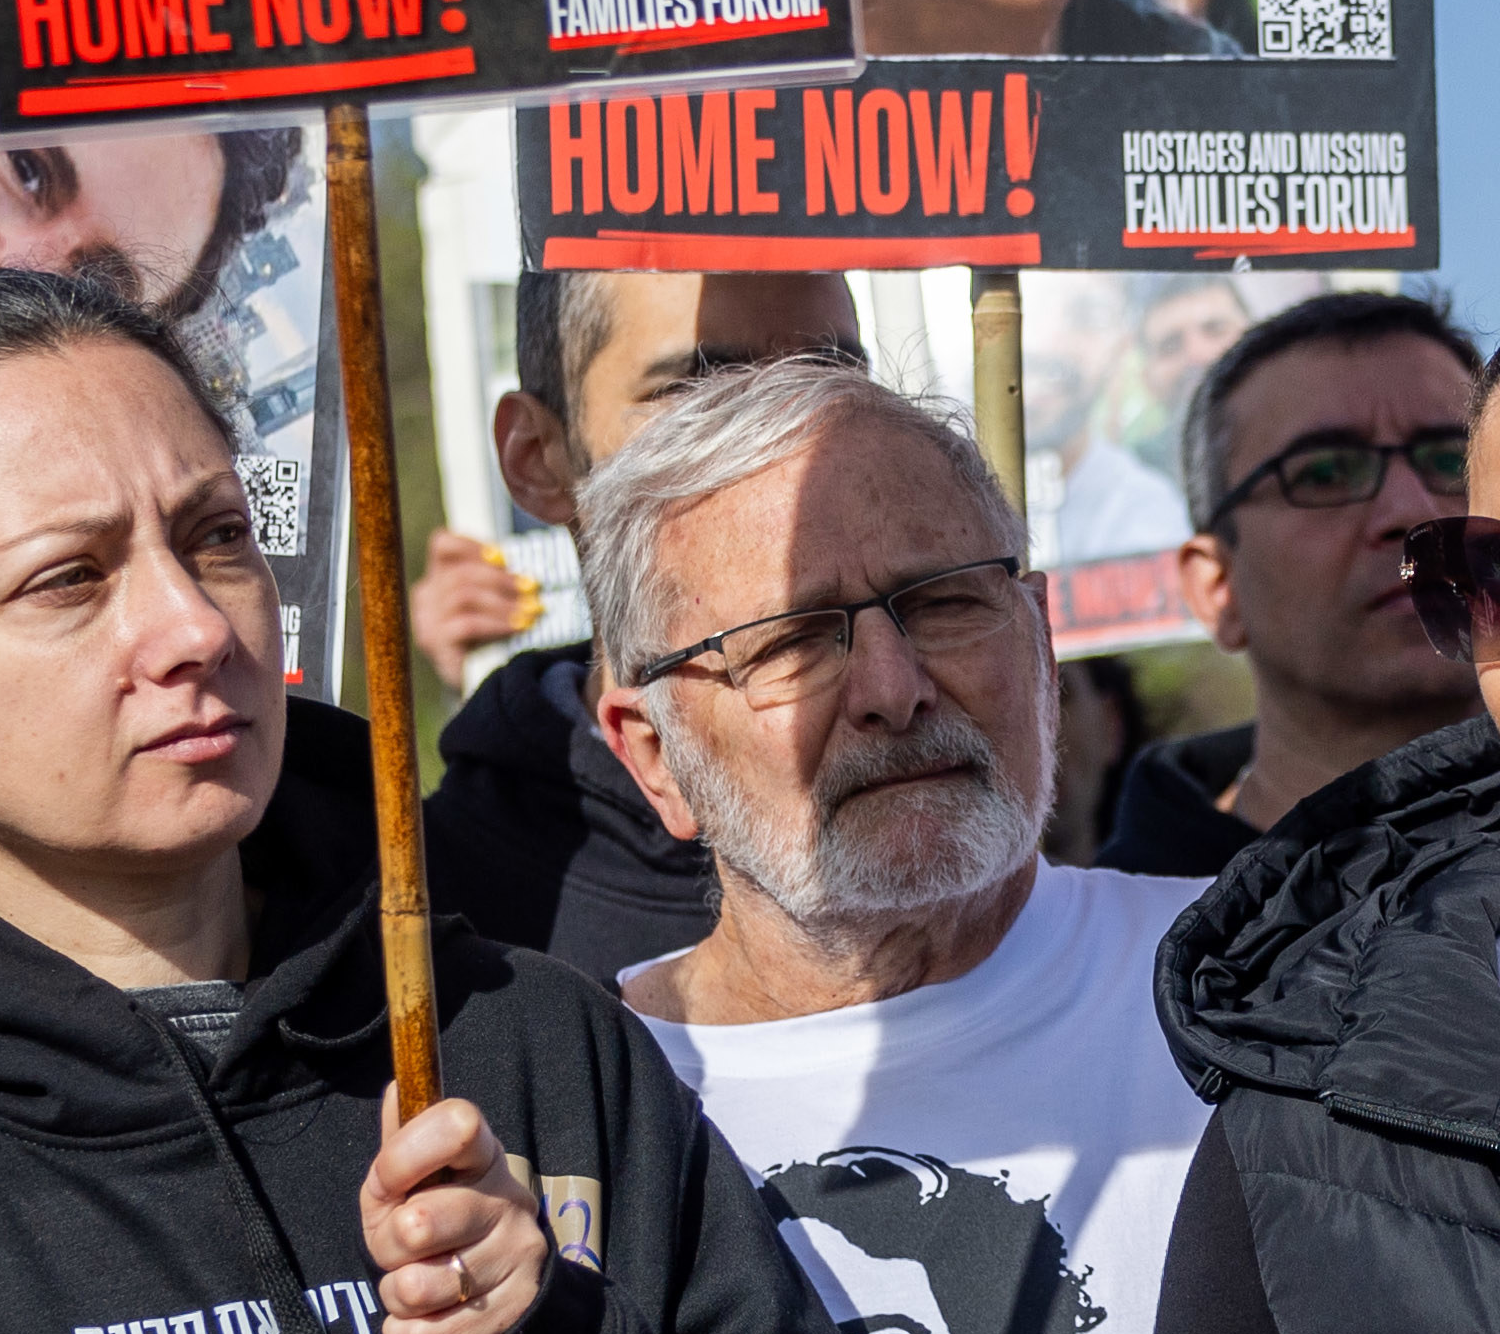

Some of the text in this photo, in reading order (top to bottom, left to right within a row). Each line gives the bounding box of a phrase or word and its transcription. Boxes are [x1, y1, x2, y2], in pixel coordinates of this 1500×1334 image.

[549, 72, 1043, 219] HOME NOW!
[1123, 131, 1406, 174] HOSTAGES AND MISSING
[1125, 175, 1410, 233] FAMILIES FORUM
